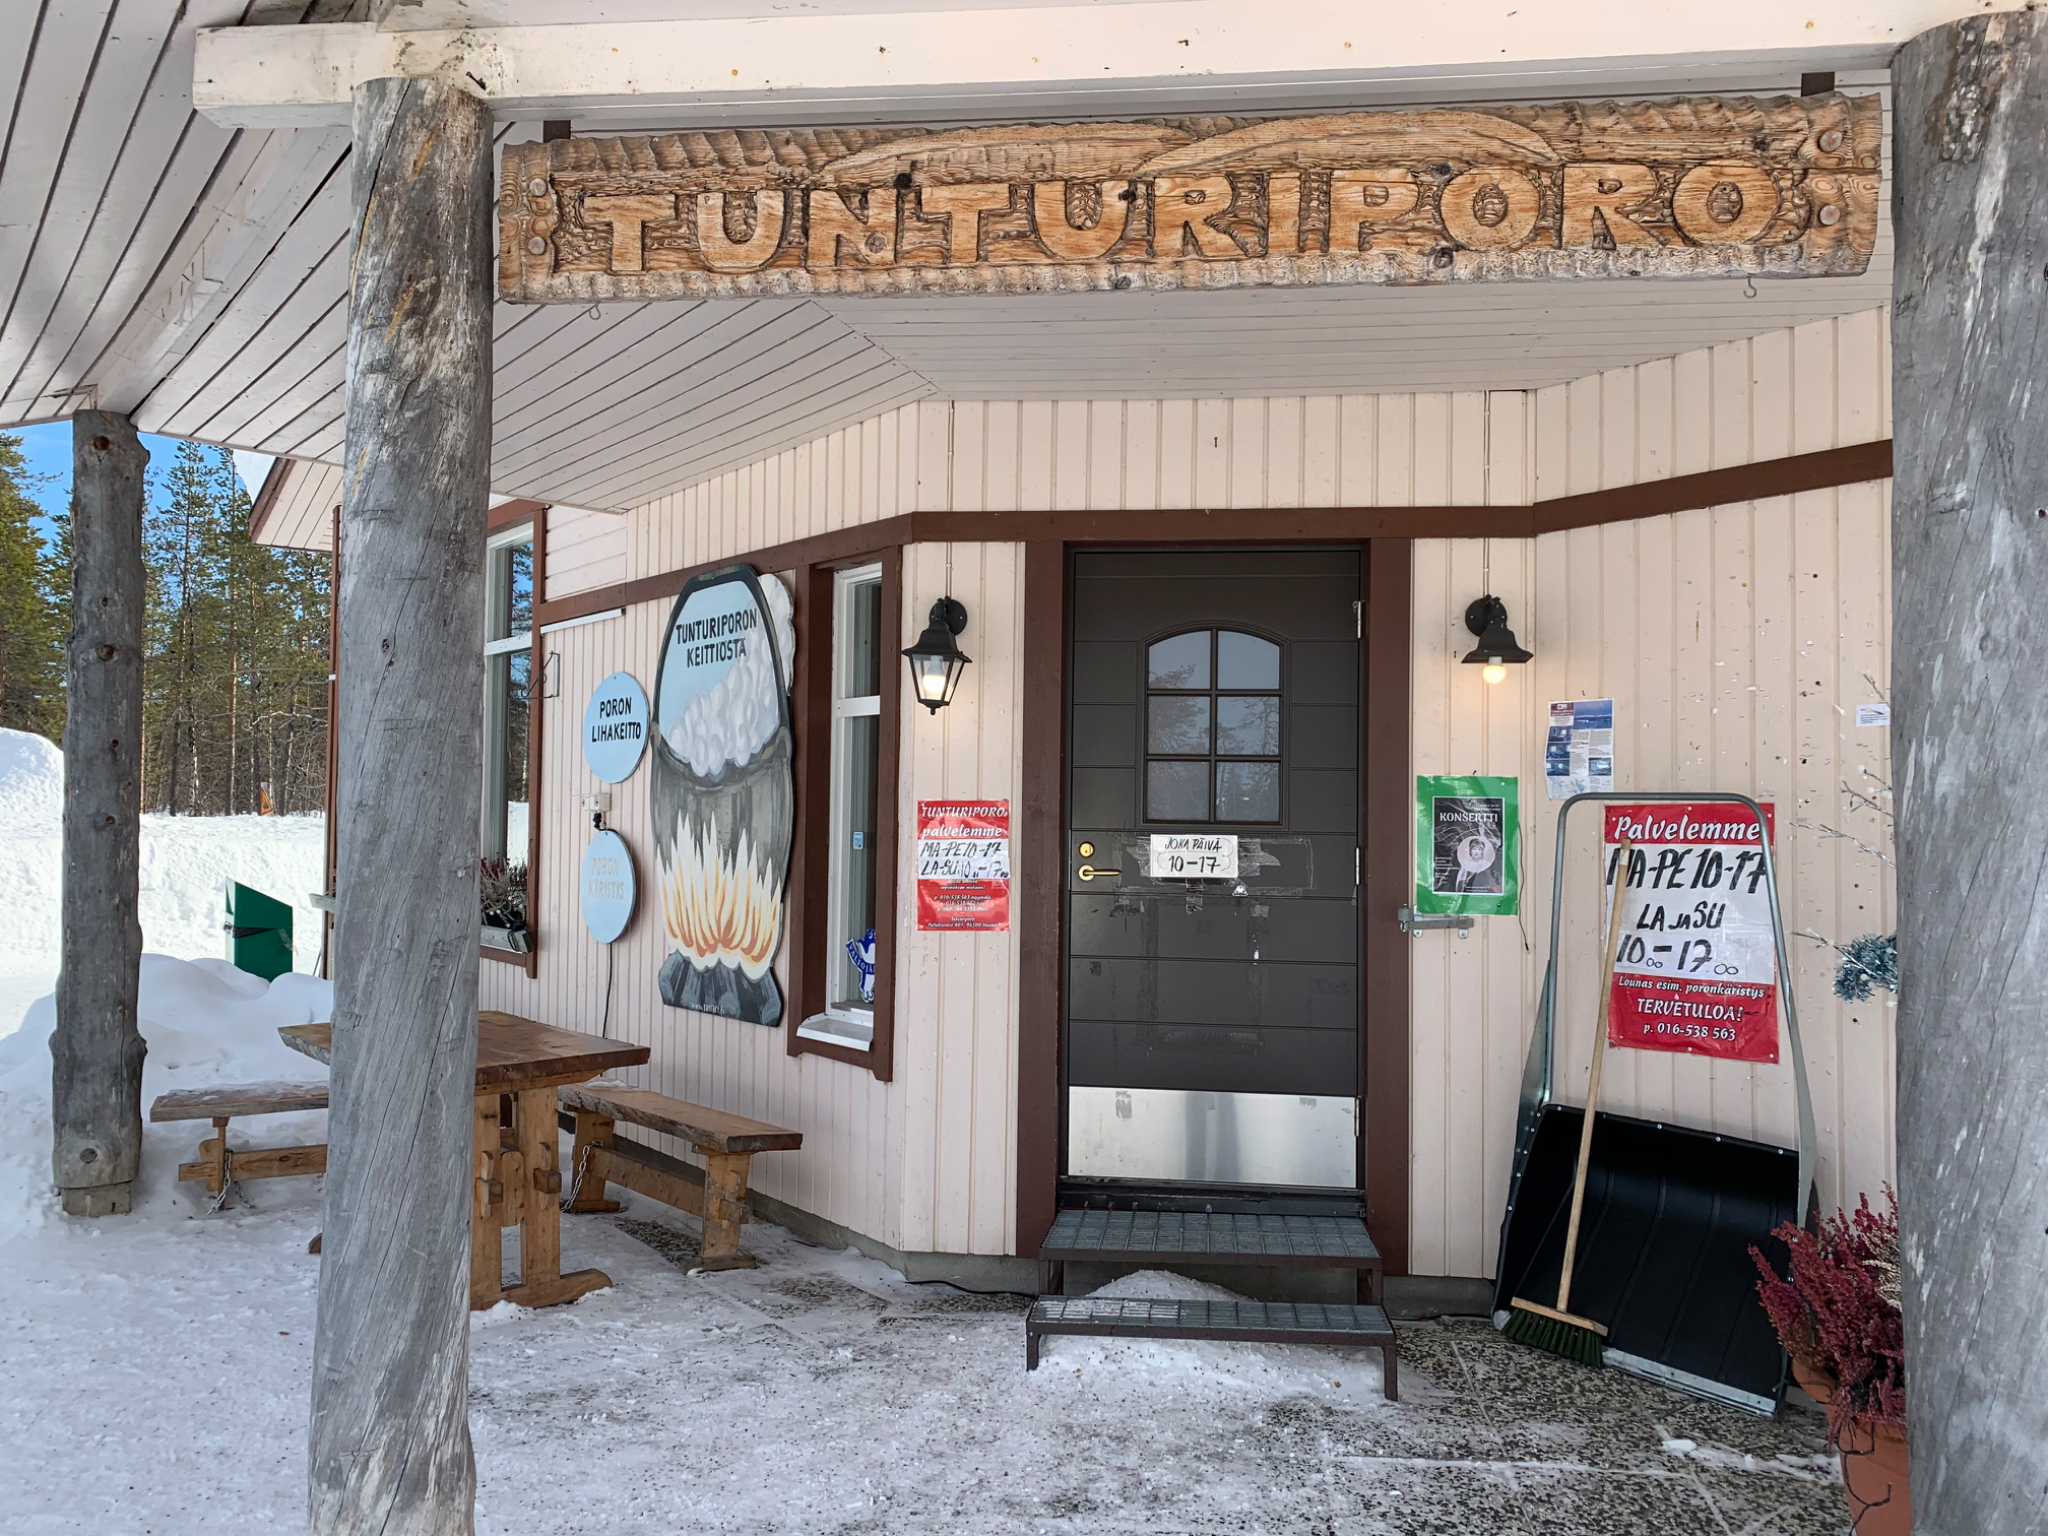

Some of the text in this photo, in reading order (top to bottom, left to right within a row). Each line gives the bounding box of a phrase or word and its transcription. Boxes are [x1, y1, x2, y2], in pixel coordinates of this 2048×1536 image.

[582, 159, 1780, 273] TUNTURIPORO
[676, 608, 757, 644] TUNTURIPORON
[687, 637, 747, 668] KEITTIÖSTÄ
[600, 697, 632, 719] PORON
[592, 722, 642, 743] LIHAKEITTO
[1440, 812, 1498, 822] KONSERTTI
[1614, 814, 1761, 841] Palvelemme
[921, 824, 1003, 840] palvelemme
[1165, 837, 1222, 852] JOKA PÄIVÄ
[592, 857, 619, 876] PORON
[1636, 903, 1665, 932] LA
[1693, 901, 1726, 929] SU
[848, 942, 876, 973] VALIOJÄ
[1618, 975, 1765, 1000] Lounas esim. poronkäristys
[1637, 998, 1744, 1022] TERVETULOA!
[1644, 1023, 1736, 1041] p. 016-538 563
